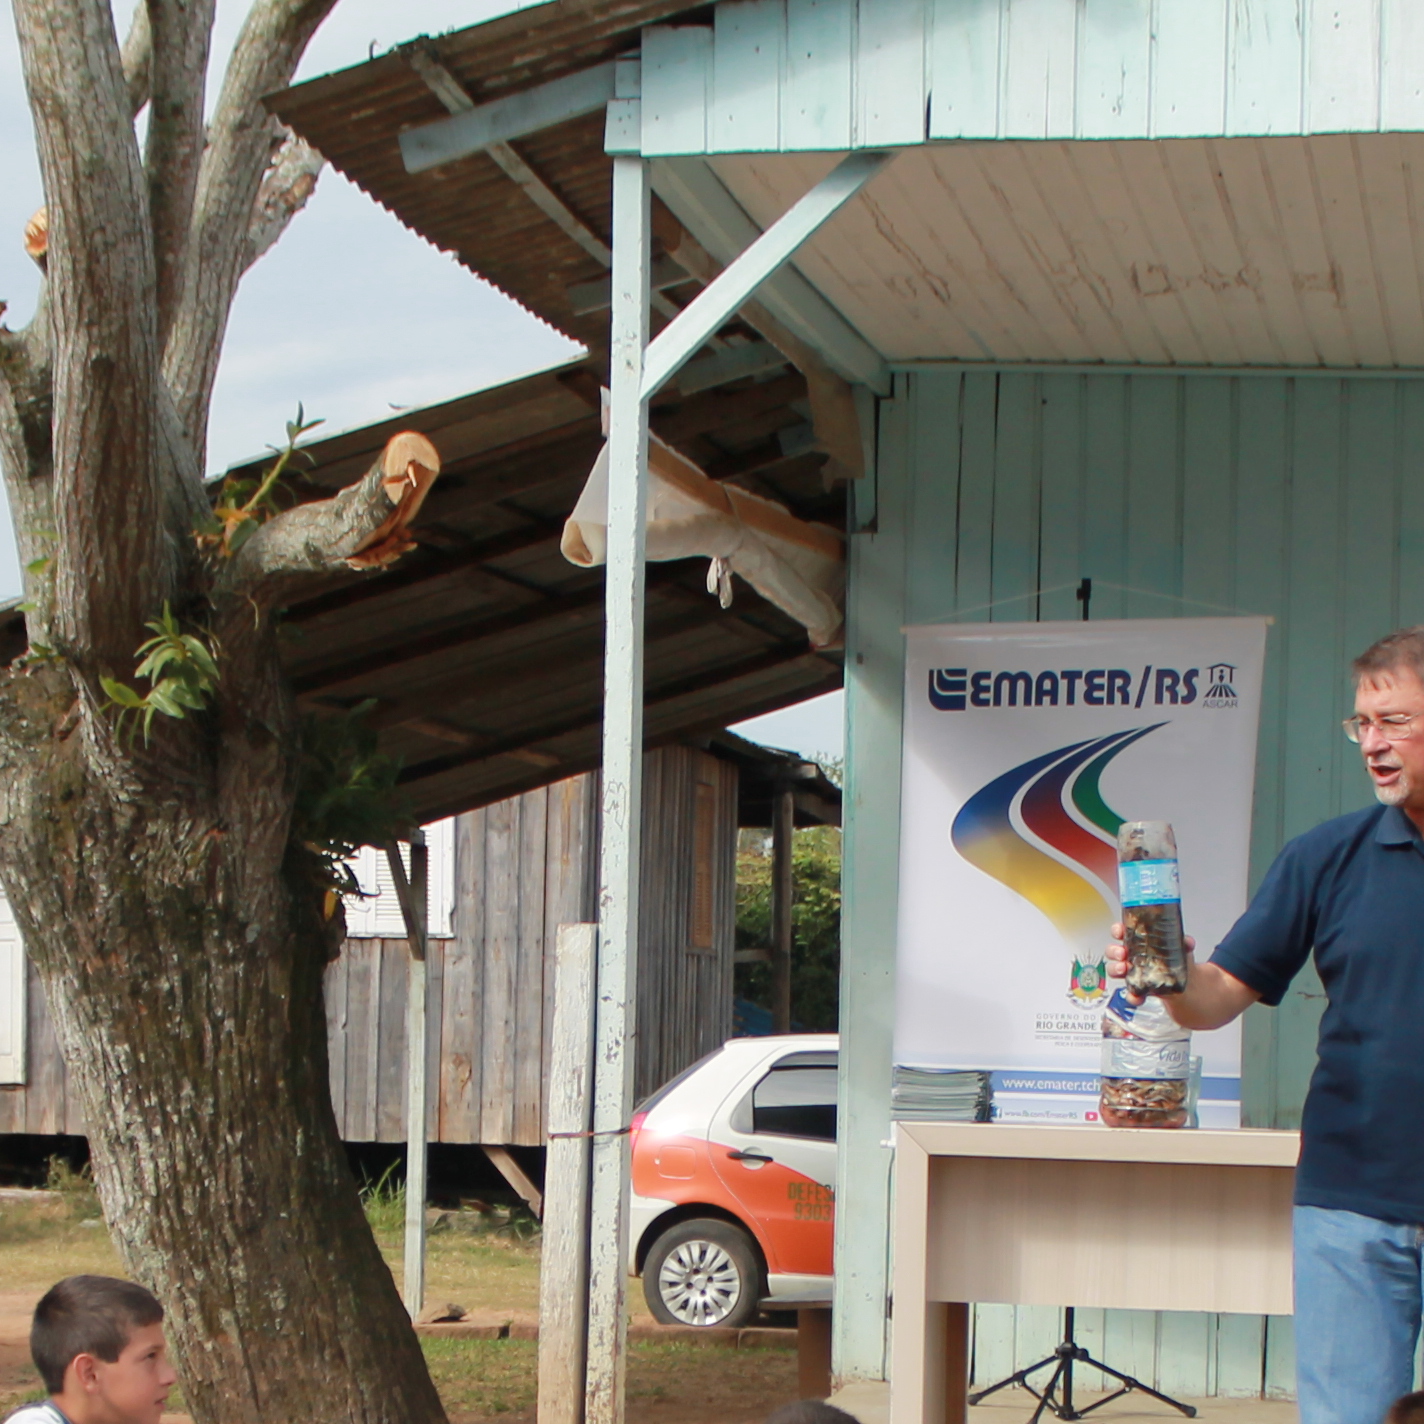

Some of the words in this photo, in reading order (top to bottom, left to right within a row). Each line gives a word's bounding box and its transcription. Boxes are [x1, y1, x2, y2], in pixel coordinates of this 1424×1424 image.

[970, 664, 1199, 709] EMATER/RS
[1202, 699, 1239, 709] ASCAR
[1036, 1013, 1079, 1021] GOVERNO
[1036, 1021, 1053, 1029] RIO
[1056, 1022, 1097, 1030] GRANDE
[788, 1182, 835, 1202] DEFES
[794, 1202, 831, 1221] 9303
